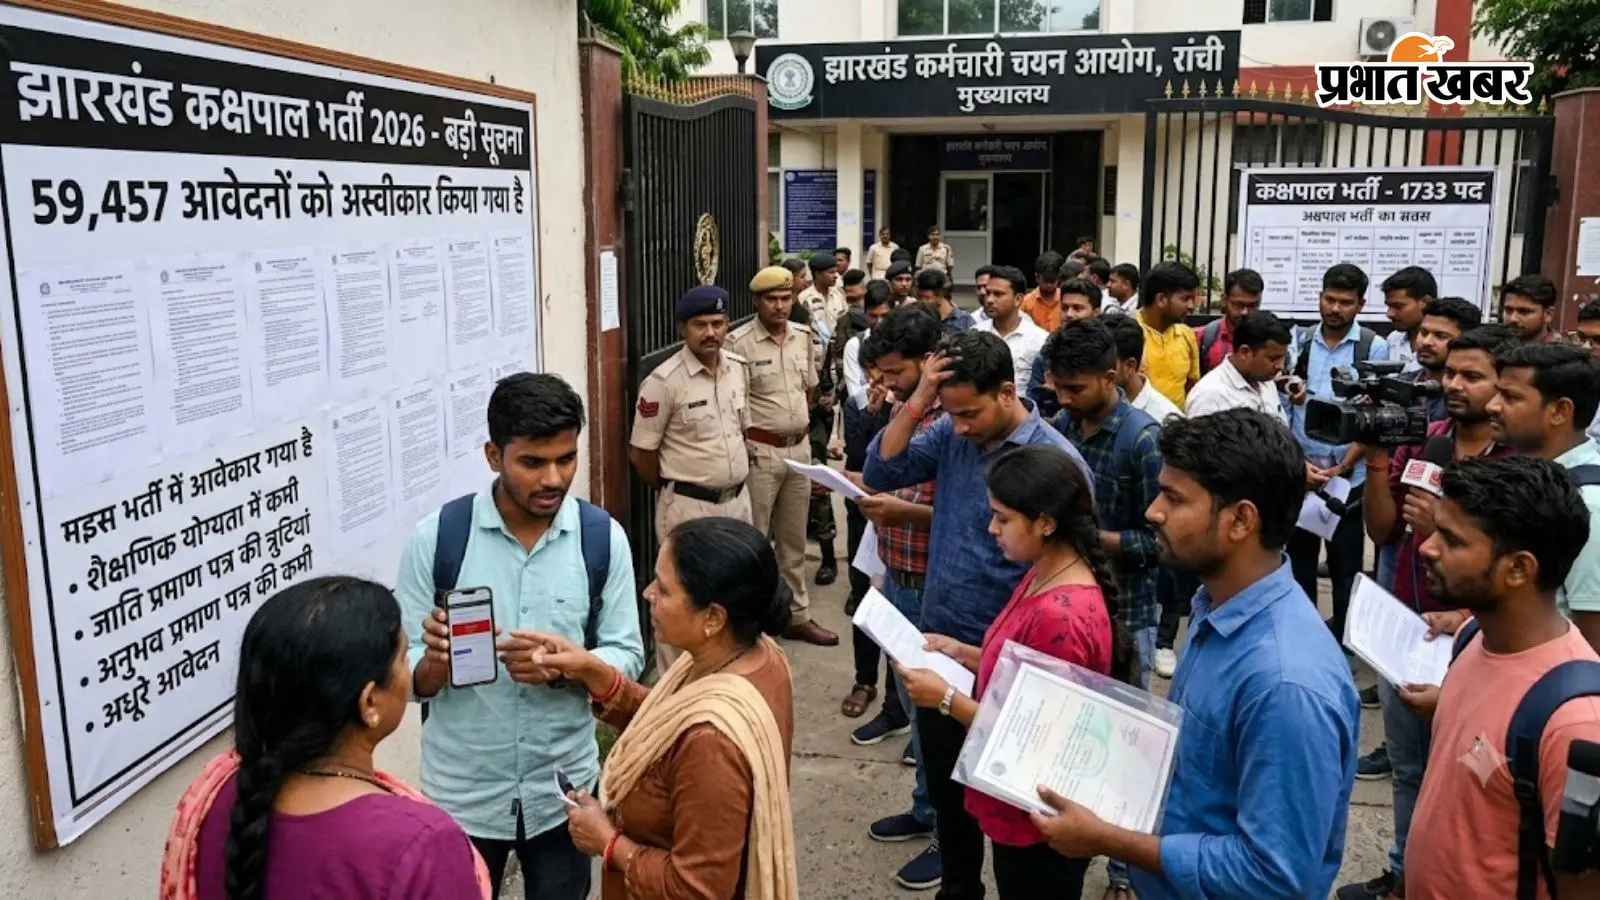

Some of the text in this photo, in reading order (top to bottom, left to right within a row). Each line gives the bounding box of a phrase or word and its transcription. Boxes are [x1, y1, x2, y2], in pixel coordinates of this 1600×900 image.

[823, 35, 1225, 84] झारखंड कर्मचारी चयन आयोग, रांची
[956, 85, 1051, 110] मुख्यालय
[10, 61, 174, 127] झारखंड
[182, 83, 310, 138] कक्षपाल
[316, 91, 364, 143] भर्ती
[371, 108, 425, 147] 2026
[443, 109, 477, 163] बड़ी
[480, 120, 523, 165] सूचना
[31, 168, 525, 231] 59,457 आवेदनों को अस्वीकार किया गया है
[1256, 183, 1336, 200] कक्षपाल
[1340, 176, 1383, 200] भर्ती
[1400, 182, 1447, 200] 1733
[1452, 181, 1486, 200] पद
[122, 479, 163, 522] भर्ती
[167, 472, 183, 504] में
[190, 452, 260, 498] आवेकार
[265, 439, 297, 468] गया
[302, 426, 313, 456] है
[87, 476, 299, 590] शैक्षणिक योग्यता में कमी
[90, 508, 310, 637] जाति प्रमाण पत्र की त्रुटियां
[98, 543, 313, 683] अनुभव प्रमाण पत्र की कमी
[103, 640, 221, 727] अधूरे आवेदन
